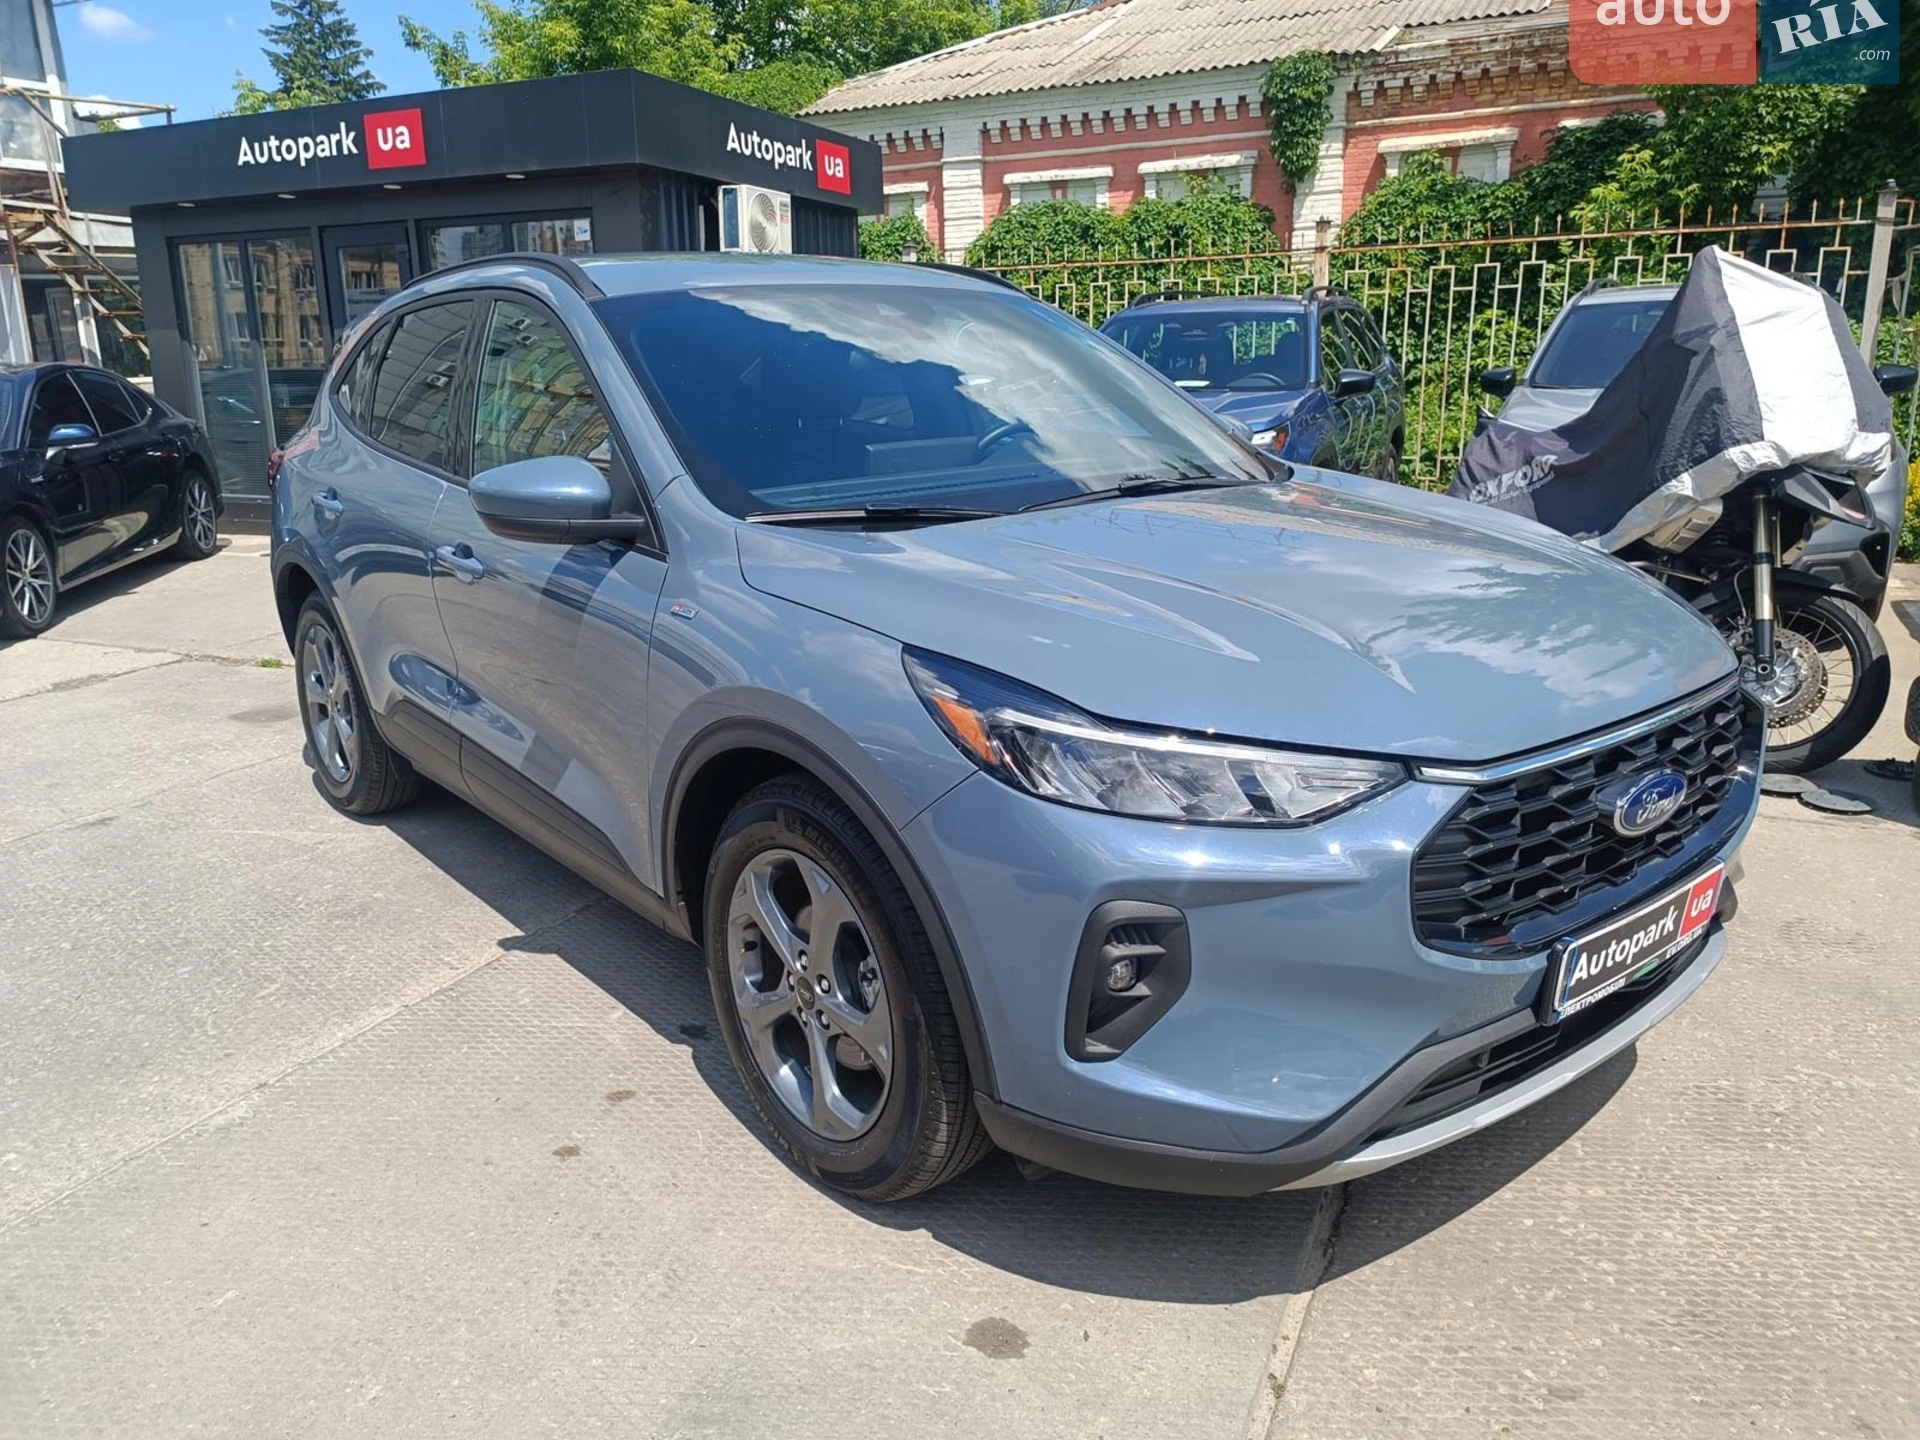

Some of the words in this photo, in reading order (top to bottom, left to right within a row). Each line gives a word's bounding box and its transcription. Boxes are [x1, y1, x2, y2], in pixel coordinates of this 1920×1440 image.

[237, 121, 359, 167] Autopark
[376, 124, 412, 152] ua
[726, 121, 814, 171] Autopark
[824, 154, 845, 179] ua
[1636, 786, 1678, 825] Ford
[1569, 905, 1679, 987] Autopark
[1690, 888, 1714, 919] ua
